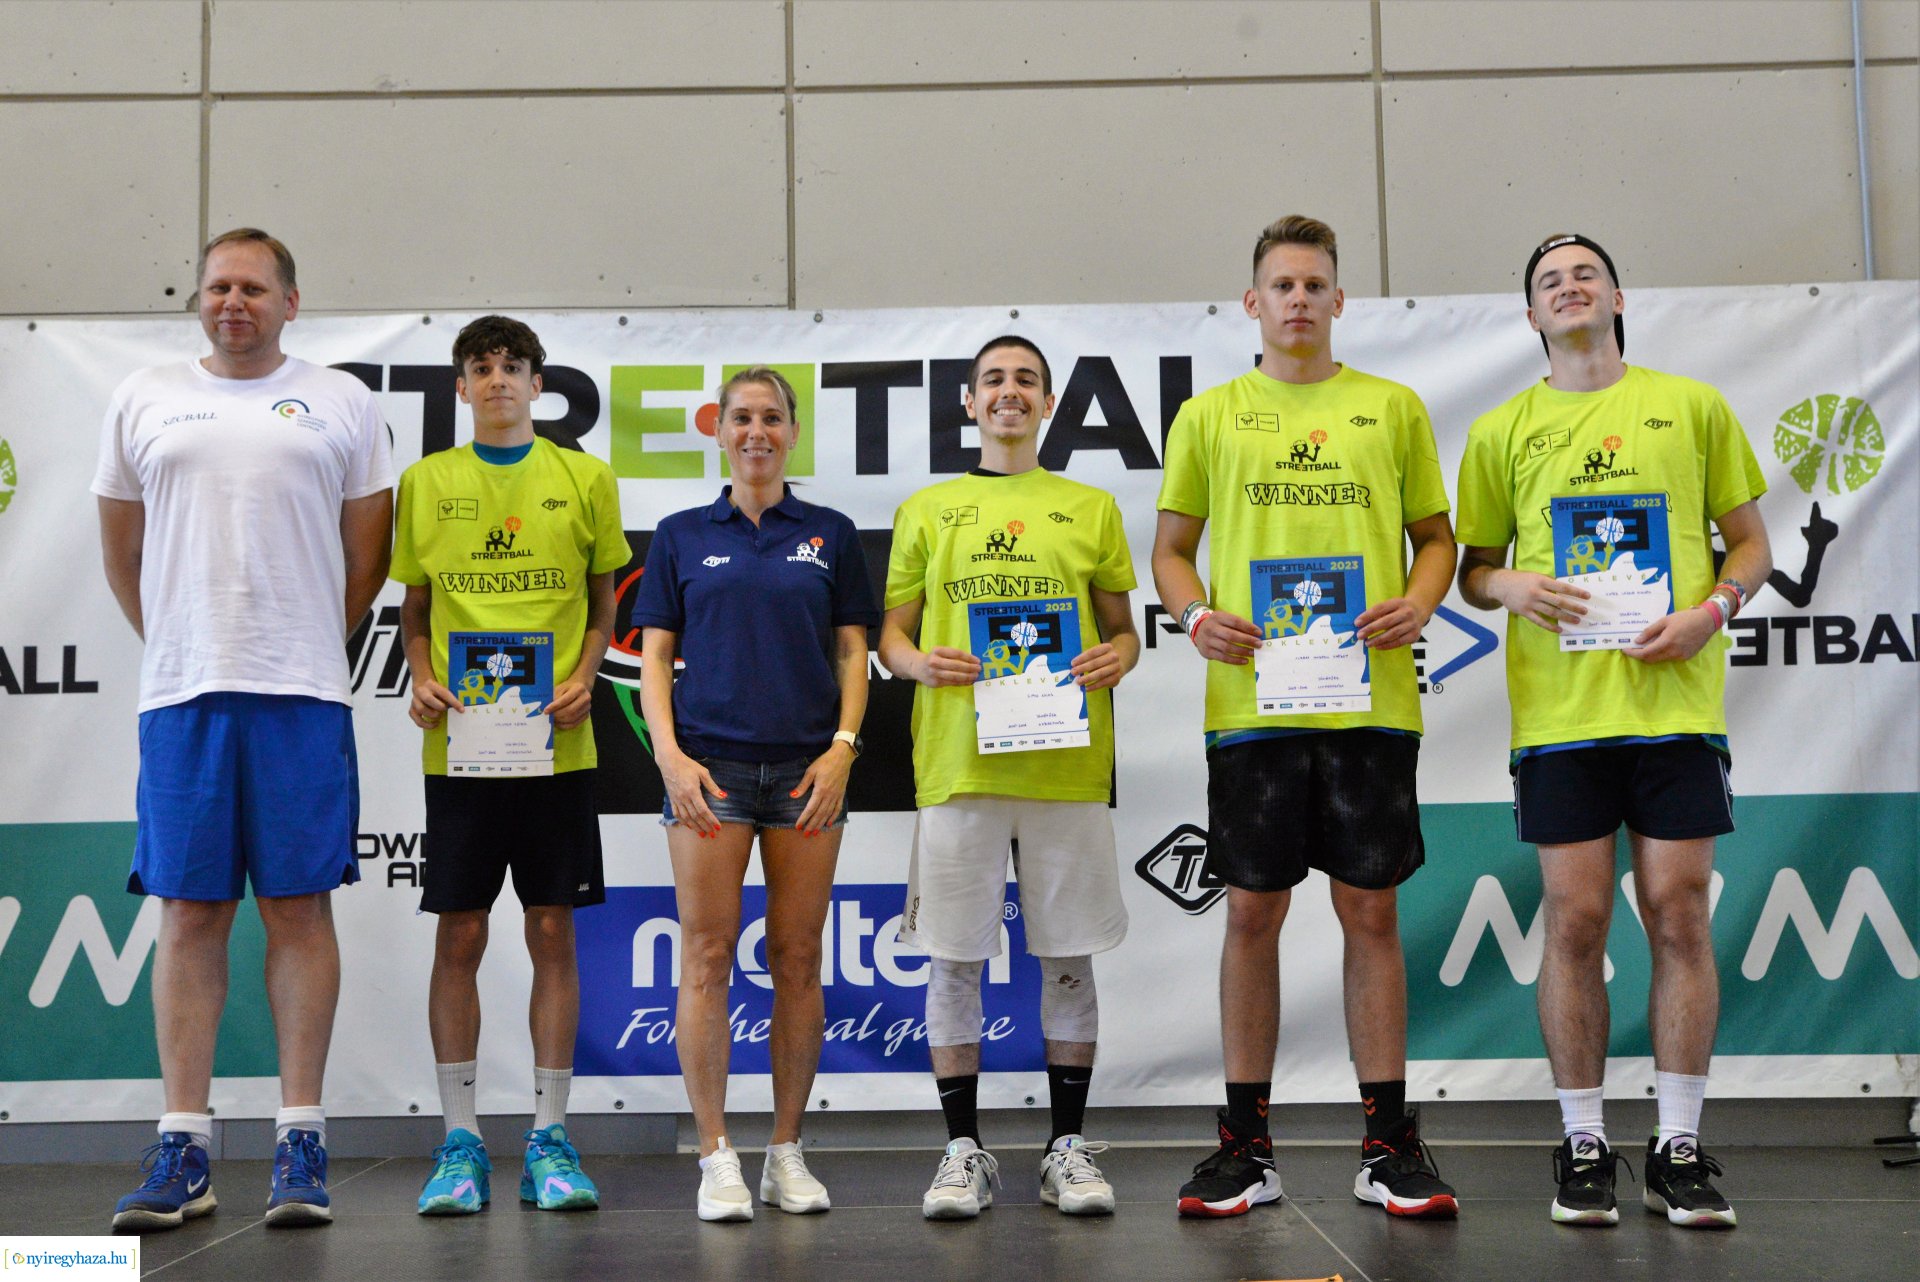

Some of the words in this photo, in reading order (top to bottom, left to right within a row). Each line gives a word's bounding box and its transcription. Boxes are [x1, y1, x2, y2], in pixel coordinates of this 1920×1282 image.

[1245, 482, 1371, 508] WINNER
[1632, 498, 1661, 508] 2023
[1330, 560, 1359, 571] 2023
[439, 568, 566, 594] WINNER
[943, 574, 1065, 603] WINNER
[1045, 602, 1073, 612] 2023
[522, 636, 549, 646] 2023
[471, 706, 544, 715] KLEVÉL
[884, 1014, 1017, 1057] gae
